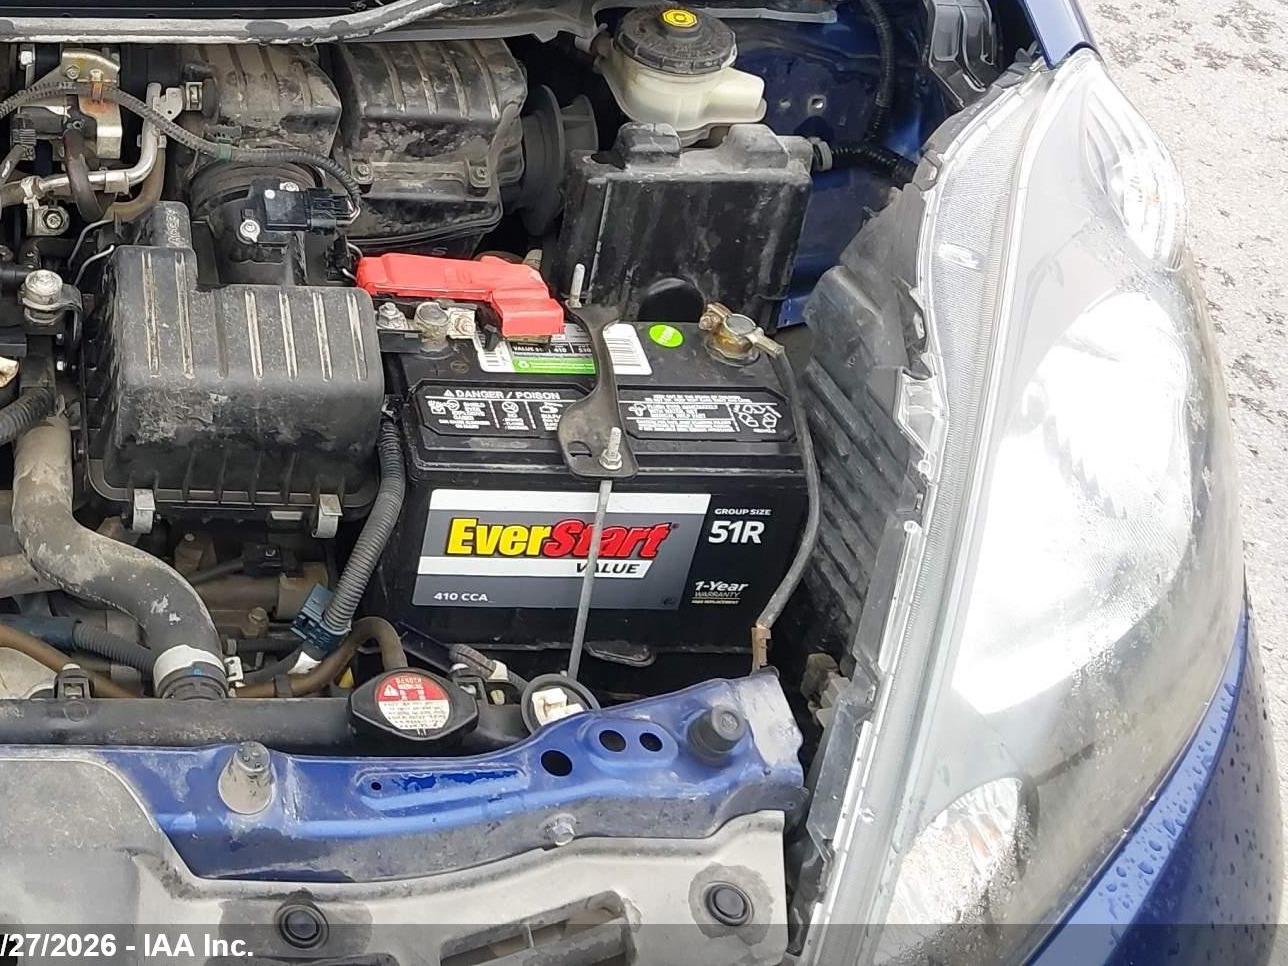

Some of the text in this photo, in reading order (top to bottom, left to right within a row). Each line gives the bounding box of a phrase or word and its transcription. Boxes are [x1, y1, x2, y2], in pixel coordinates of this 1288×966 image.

[455, 390, 504, 399] DANGER
[515, 391, 561, 400] POISON
[708, 520, 765, 544] 51R
[446, 517, 672, 559] EverStart
[695, 581, 750, 592] 1-Year
[433, 592, 489, 603] 410 CCA
